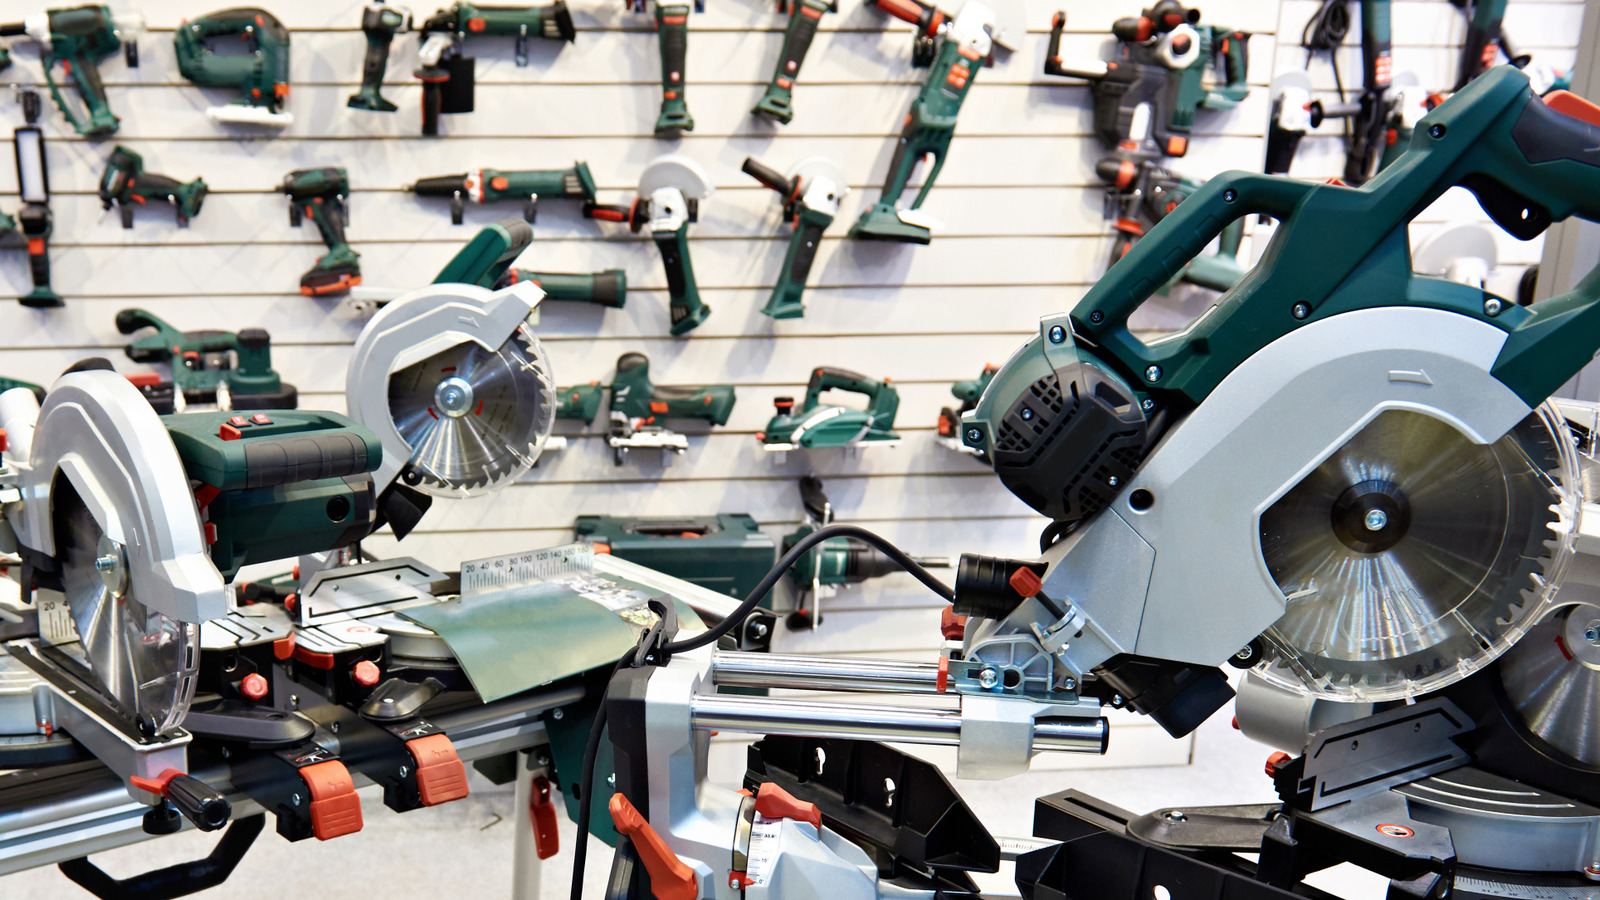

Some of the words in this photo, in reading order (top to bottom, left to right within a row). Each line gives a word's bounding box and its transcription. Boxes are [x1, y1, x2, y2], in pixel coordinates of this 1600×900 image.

[466, 565, 475, 573] 20
[480, 562, 489, 570] 40
[509, 557, 518, 565] 80
[520, 555, 532, 563] 100
[536, 552, 548, 560] 120
[550, 550, 561, 558] 140
[564, 548, 575, 556] 160
[43, 602, 55, 611] 20
